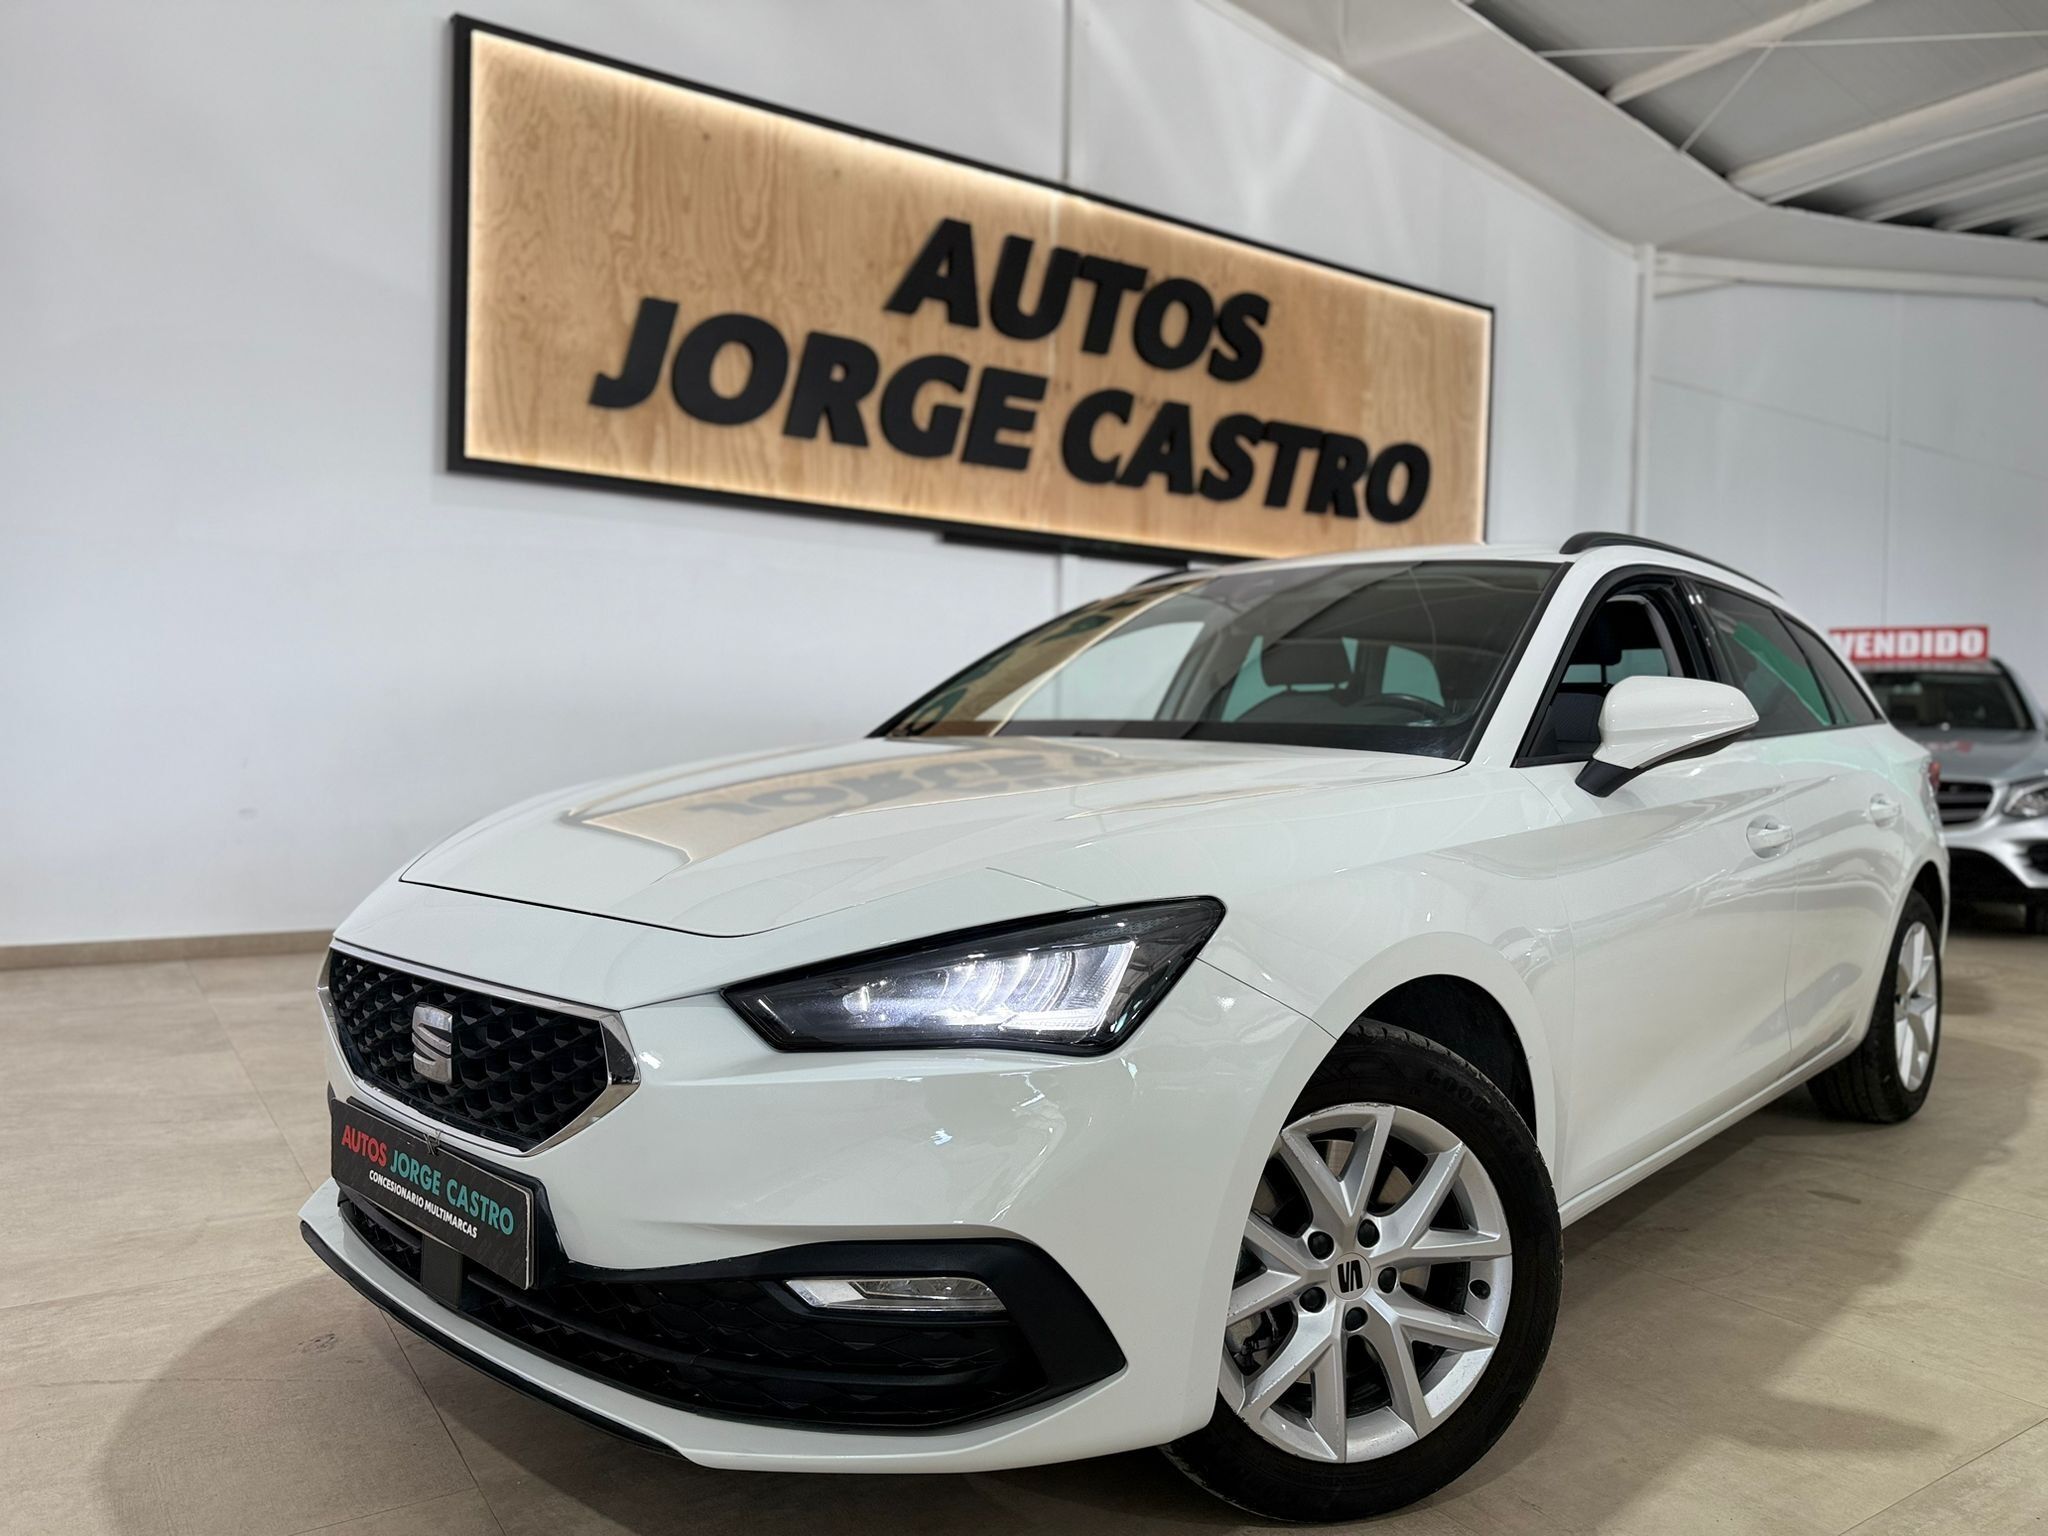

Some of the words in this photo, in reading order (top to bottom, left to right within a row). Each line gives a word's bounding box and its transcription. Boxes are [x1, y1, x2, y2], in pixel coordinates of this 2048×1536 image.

[883, 218, 1271, 383] AUTOS
[588, 296, 1048, 471] JORGE
[1061, 388, 1432, 525] CASTRO
[1832, 629, 1986, 659] VENDIDO
[341, 1125, 388, 1167] AUTOS
[390, 1150, 442, 1197] JORGE
[446, 1178, 515, 1236] CASTRO
[369, 1170, 424, 1209] CONCESIONARIO
[423, 1200, 478, 1239] MULTIMARCAS
